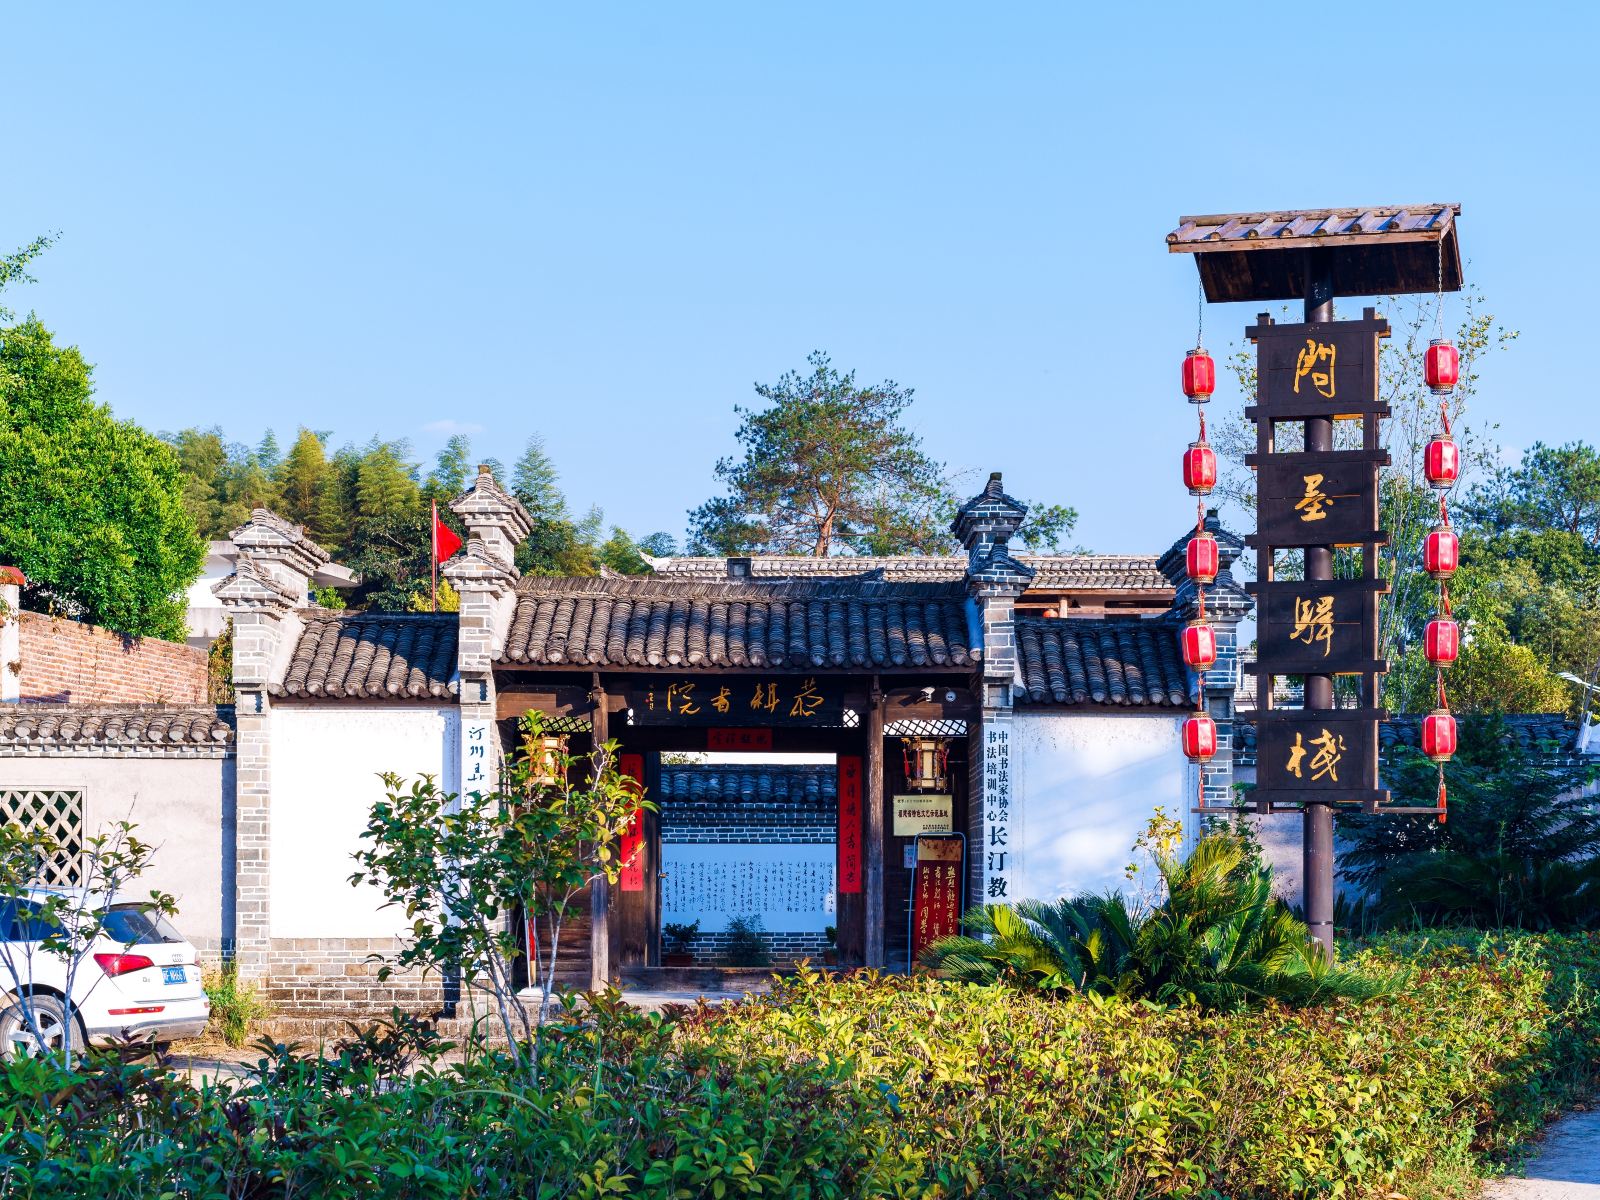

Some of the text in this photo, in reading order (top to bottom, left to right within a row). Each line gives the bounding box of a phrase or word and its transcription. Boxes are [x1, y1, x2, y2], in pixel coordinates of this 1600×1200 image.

[986, 730, 997, 822] 书法培训中心
[998, 730, 1009, 822] 中国书法家协会
[987, 826, 1008, 898] 长汀教
